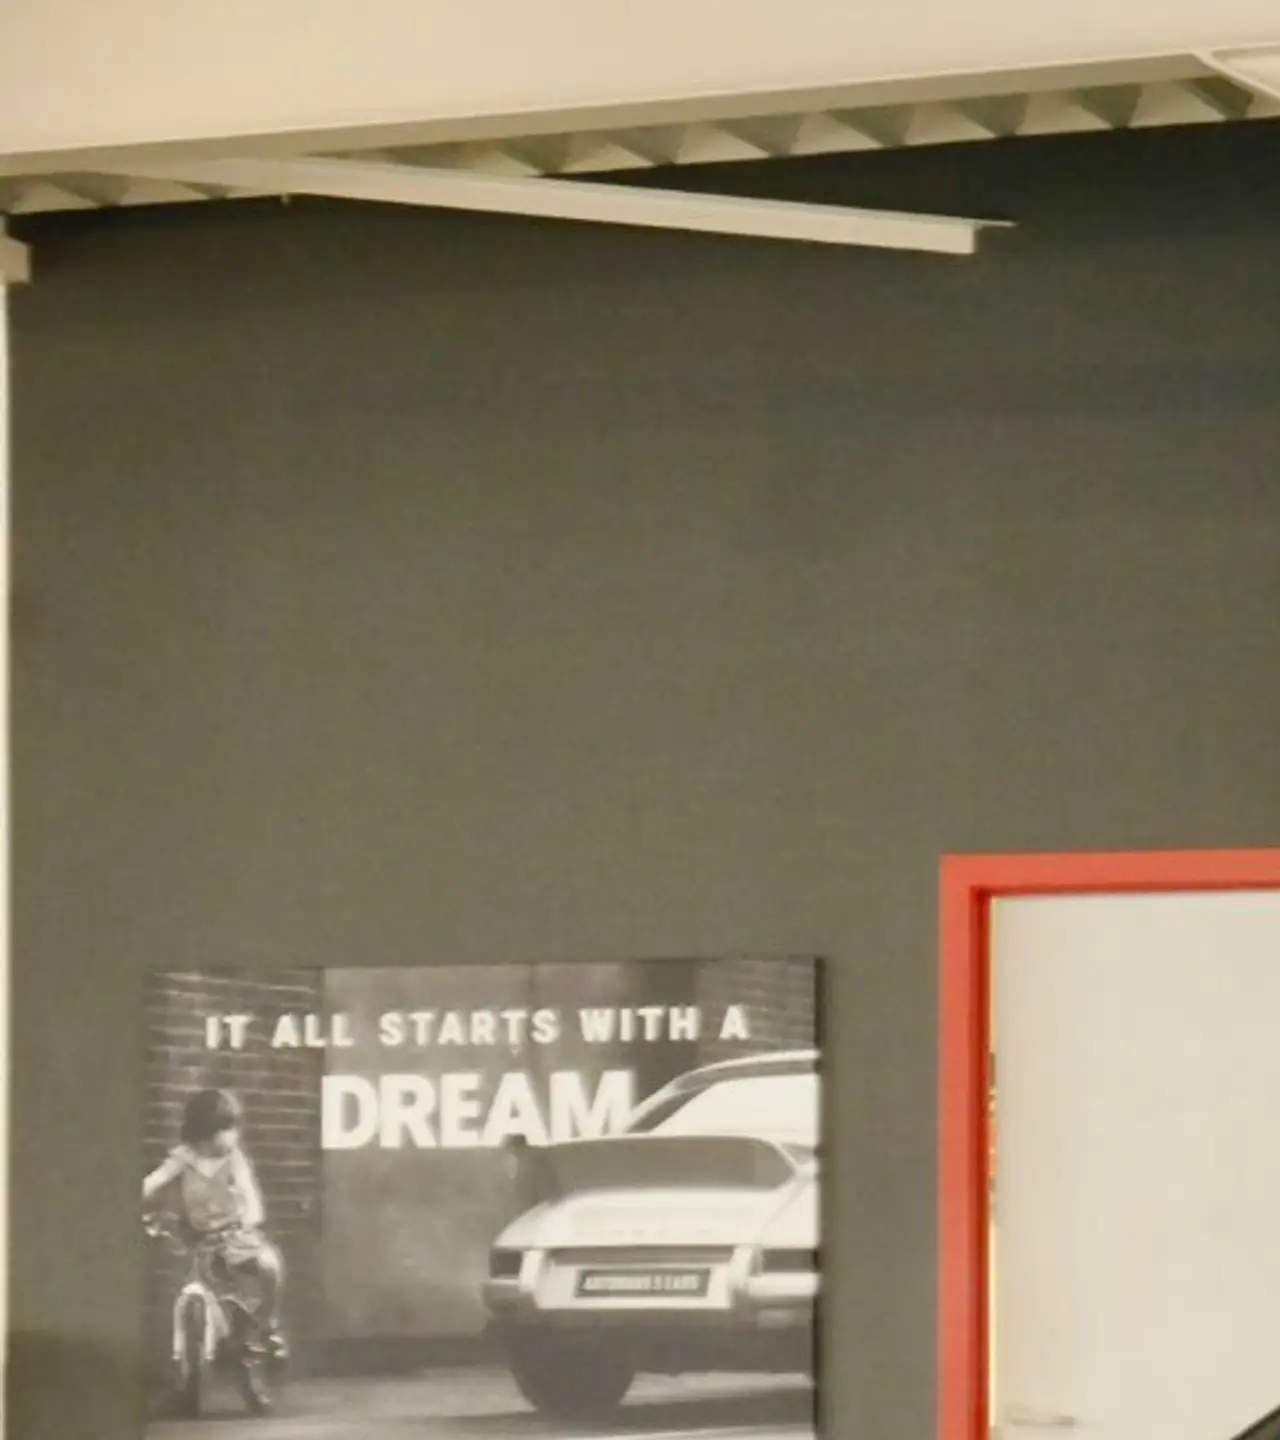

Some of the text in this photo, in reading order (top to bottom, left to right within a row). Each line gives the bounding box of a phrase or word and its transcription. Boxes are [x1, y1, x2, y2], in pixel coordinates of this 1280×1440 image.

[204, 1005, 751, 1049] IT ALL STARTS WITH A
[321, 1070, 636, 1149] DREAM
